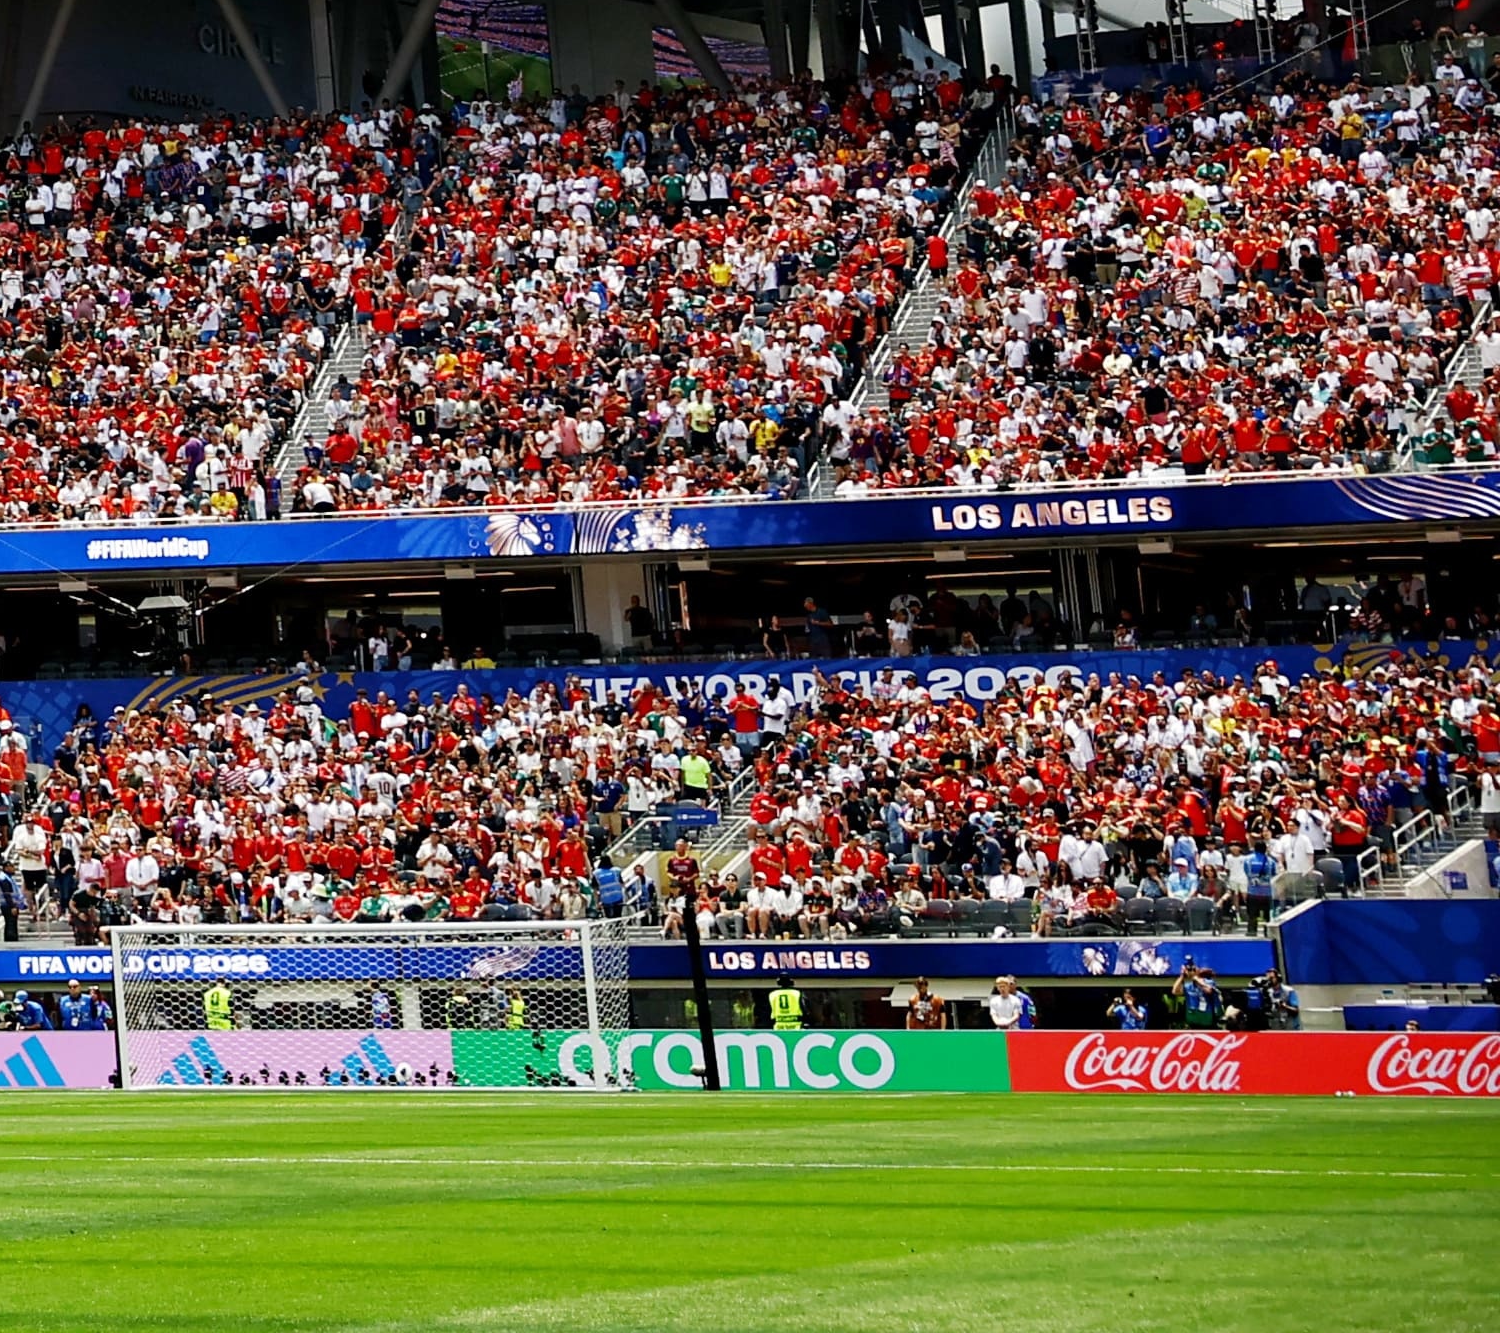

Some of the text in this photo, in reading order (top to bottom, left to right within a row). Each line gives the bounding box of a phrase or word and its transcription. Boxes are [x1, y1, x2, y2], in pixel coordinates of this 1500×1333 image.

[933, 497, 1172, 530] LOS ANGELES
[19, 954, 270, 974] FIFA WORD CUP 2026
[710, 952, 869, 969] LOS ANGELES
[558, 1032, 896, 1089] aramco
[1064, 1033, 1248, 1092] Coca-Cola
